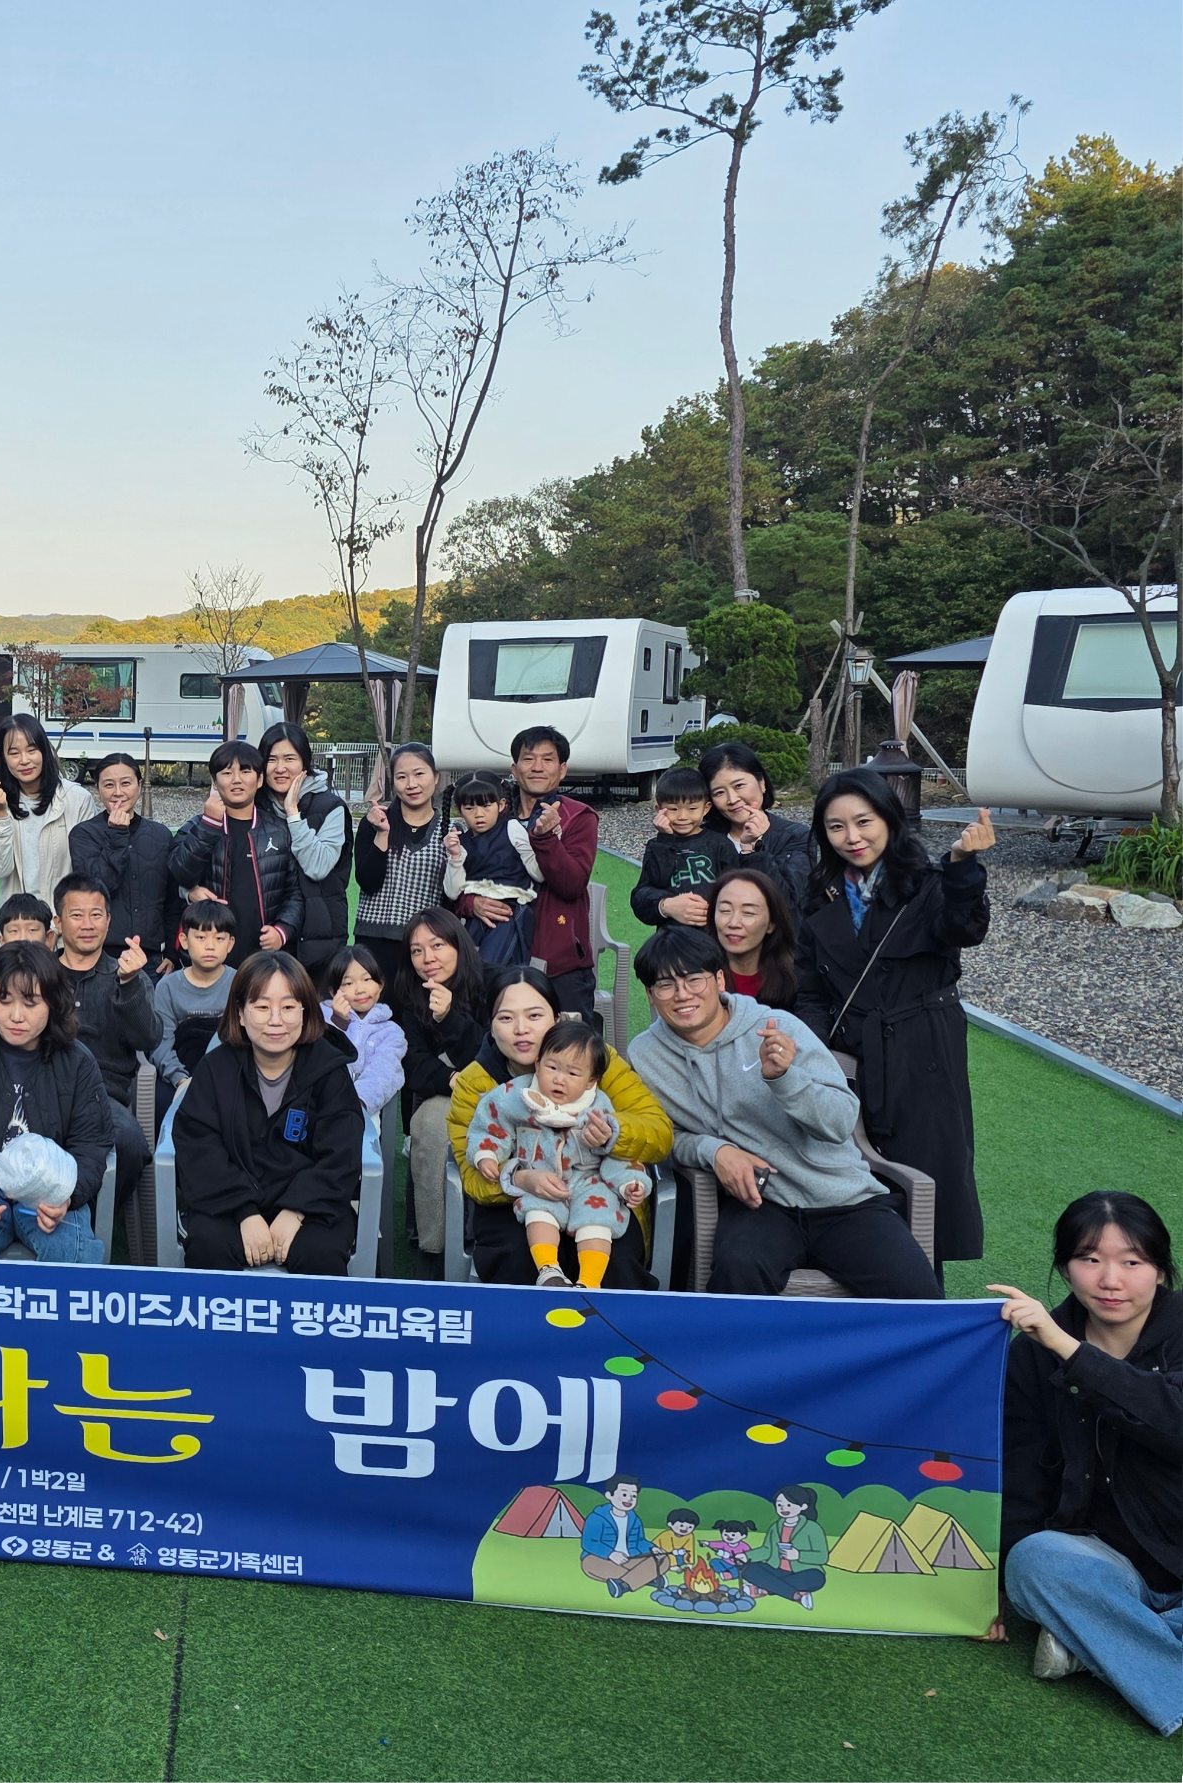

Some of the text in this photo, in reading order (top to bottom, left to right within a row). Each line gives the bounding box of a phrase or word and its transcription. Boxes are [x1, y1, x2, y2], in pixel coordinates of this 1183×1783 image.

[283, 1108, 309, 1142] B
[70, 1290, 282, 1334] 라이즈사업단
[290, 1301, 473, 1345] 평생교육팀
[300, 1365, 622, 1484] 밤에
[17, 1468, 86, 1492] 1박2일
[43, 1504, 104, 1529] 난계로
[108, 1509, 203, 1536] 712-42)
[31, 1539, 93, 1561] 영동군
[97, 1544, 116, 1562] &
[157, 1547, 303, 1576] 영동군가족센터
